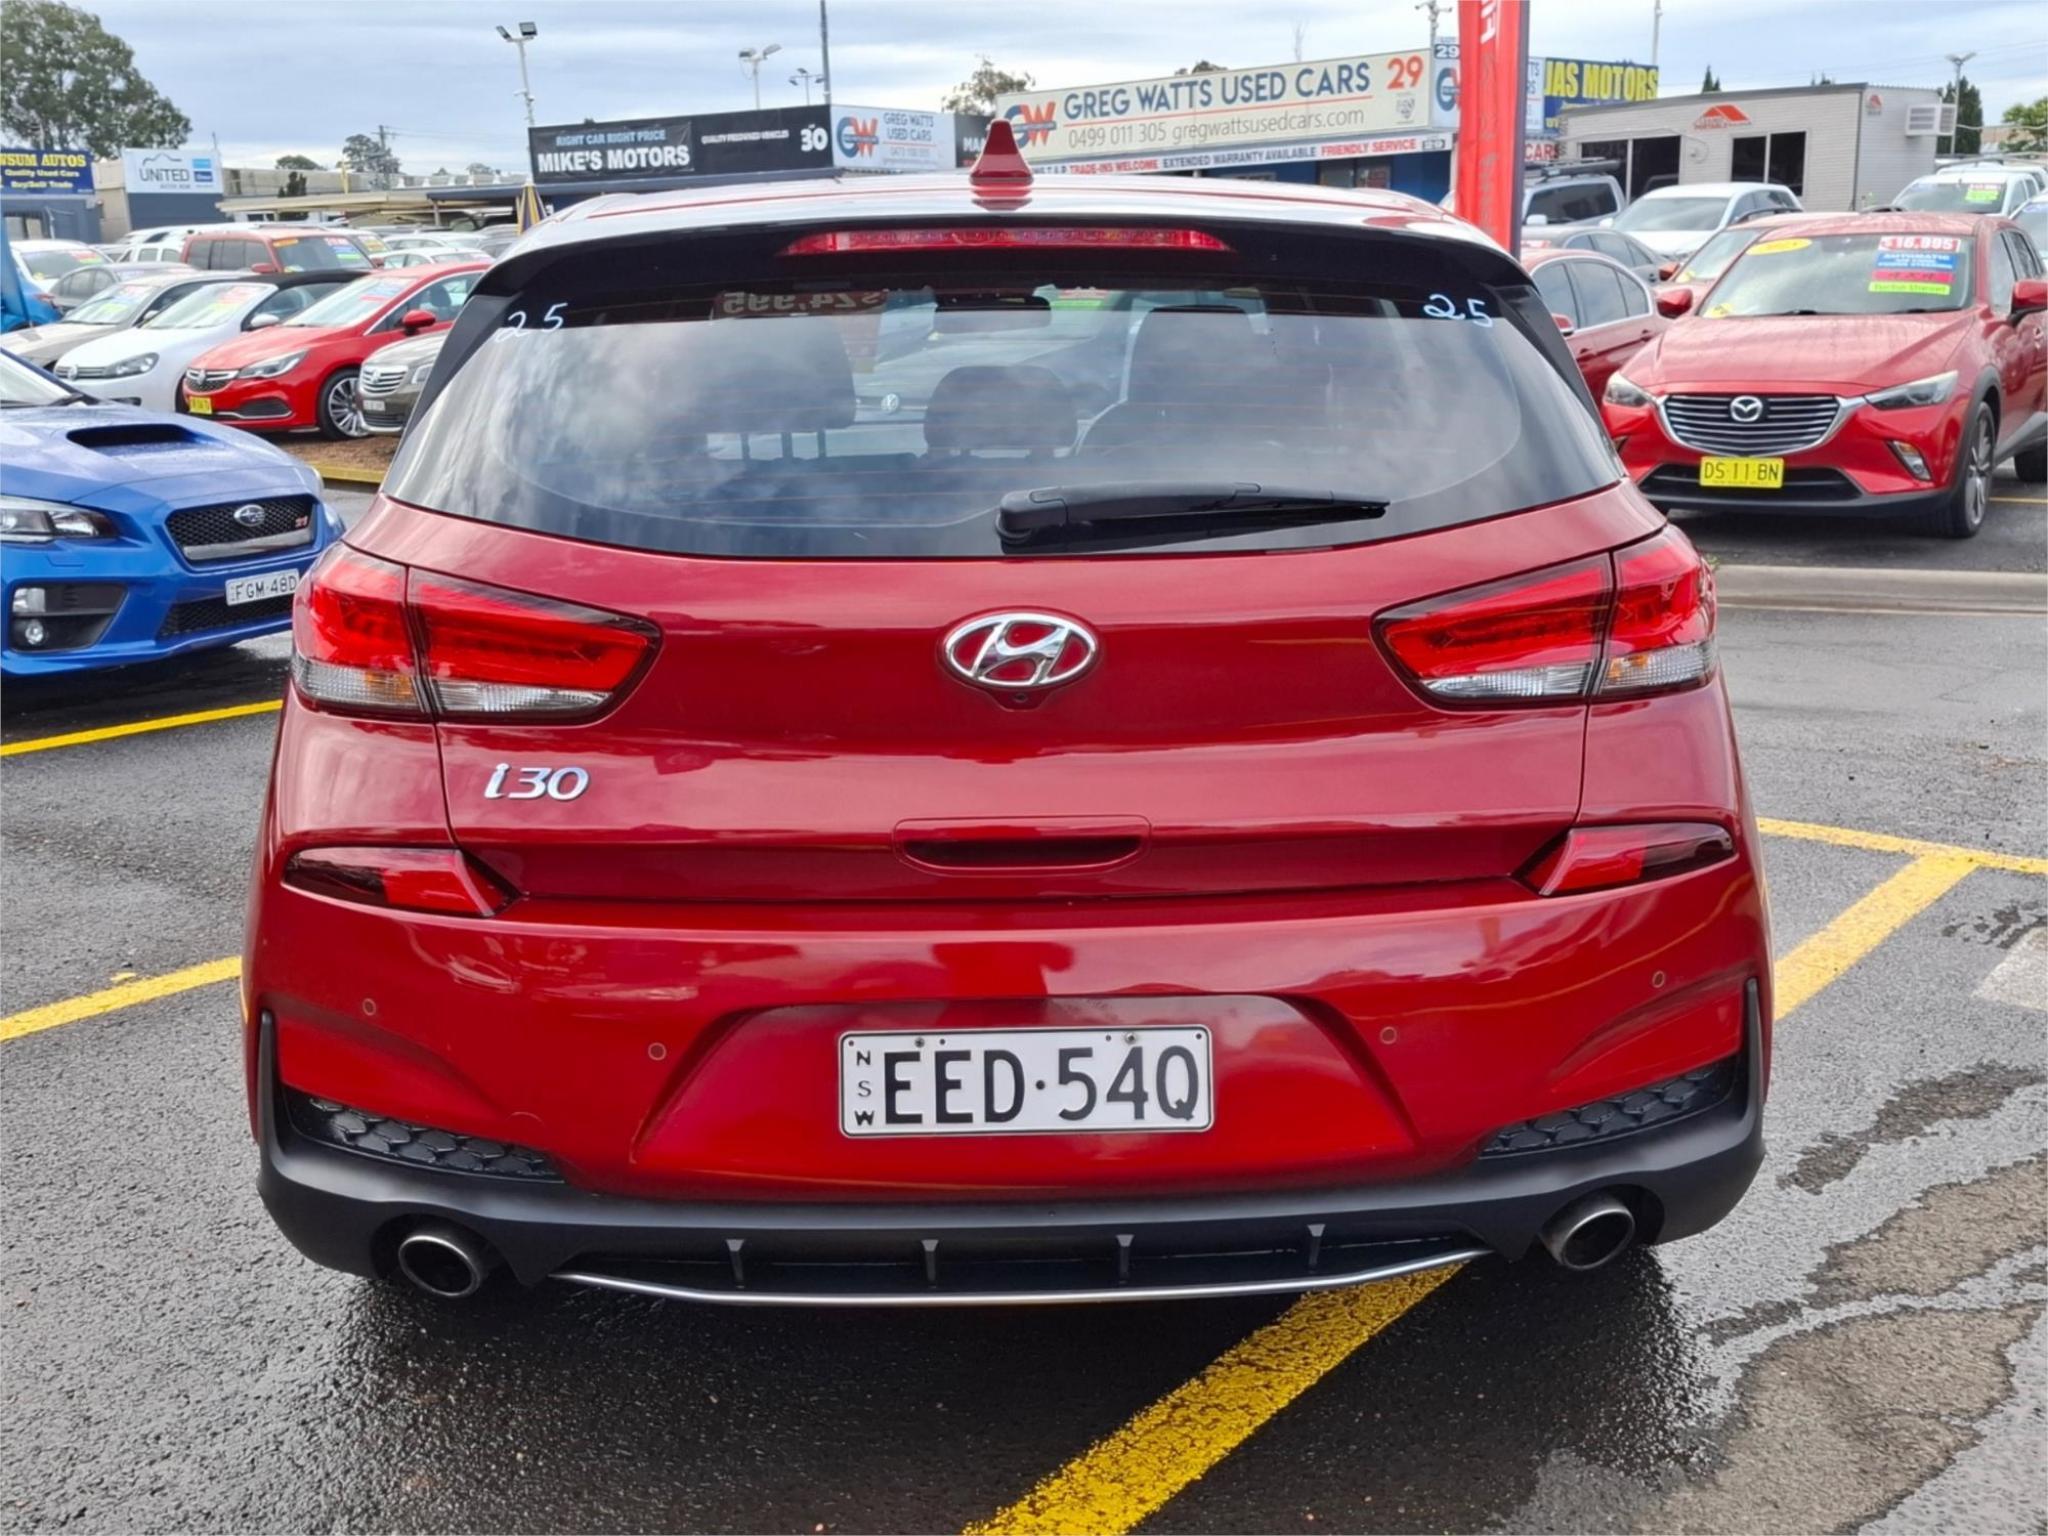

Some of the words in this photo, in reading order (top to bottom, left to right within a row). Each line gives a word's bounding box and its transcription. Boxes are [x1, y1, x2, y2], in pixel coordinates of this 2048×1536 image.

[1436, 46, 1460, 58] 29
[1386, 55, 1424, 90] 29
[1582, 63, 1658, 101] MOTORS
[1064, 89, 1130, 120] GREG
[1136, 79, 1212, 113] WATTS
[1221, 71, 1286, 105] USED
[1295, 62, 1371, 98] CARS
[883, 112, 908, 125] GREG
[909, 114, 934, 128] WATTS
[1068, 127, 1106, 149] 0499
[1110, 125, 1134, 145] 011
[1138, 122, 1167, 143] 305
[1172, 108, 1364, 145] gregwattsusedcars.com
[555, 134, 584, 146] RIGHT
[586, 133, 605, 145] CAR
[607, 131, 635, 144] RIGHT
[637, 129, 666, 142] PRICE
[801, 127, 828, 152] 30
[886, 128, 908, 140] USED
[909, 129, 932, 142] CARS
[41, 153, 86, 167] AUTOS
[537, 150, 603, 172] MIKE'S
[607, 145, 690, 169] MOTORS
[1069, 162, 1113, 175] TRADE-INS
[1116, 159, 1158, 171] WELCOME
[1163, 154, 1210, 169] EXTENDED
[1213, 150, 1264, 164] WARRANTY
[1265, 146, 1316, 160] AVAILABLE
[1320, 142, 1369, 156] FRIENDLY
[1371, 138, 1416, 152] SERVICE
[140, 168, 190, 182] UNITED
[1423, 294, 1493, 328] 25
